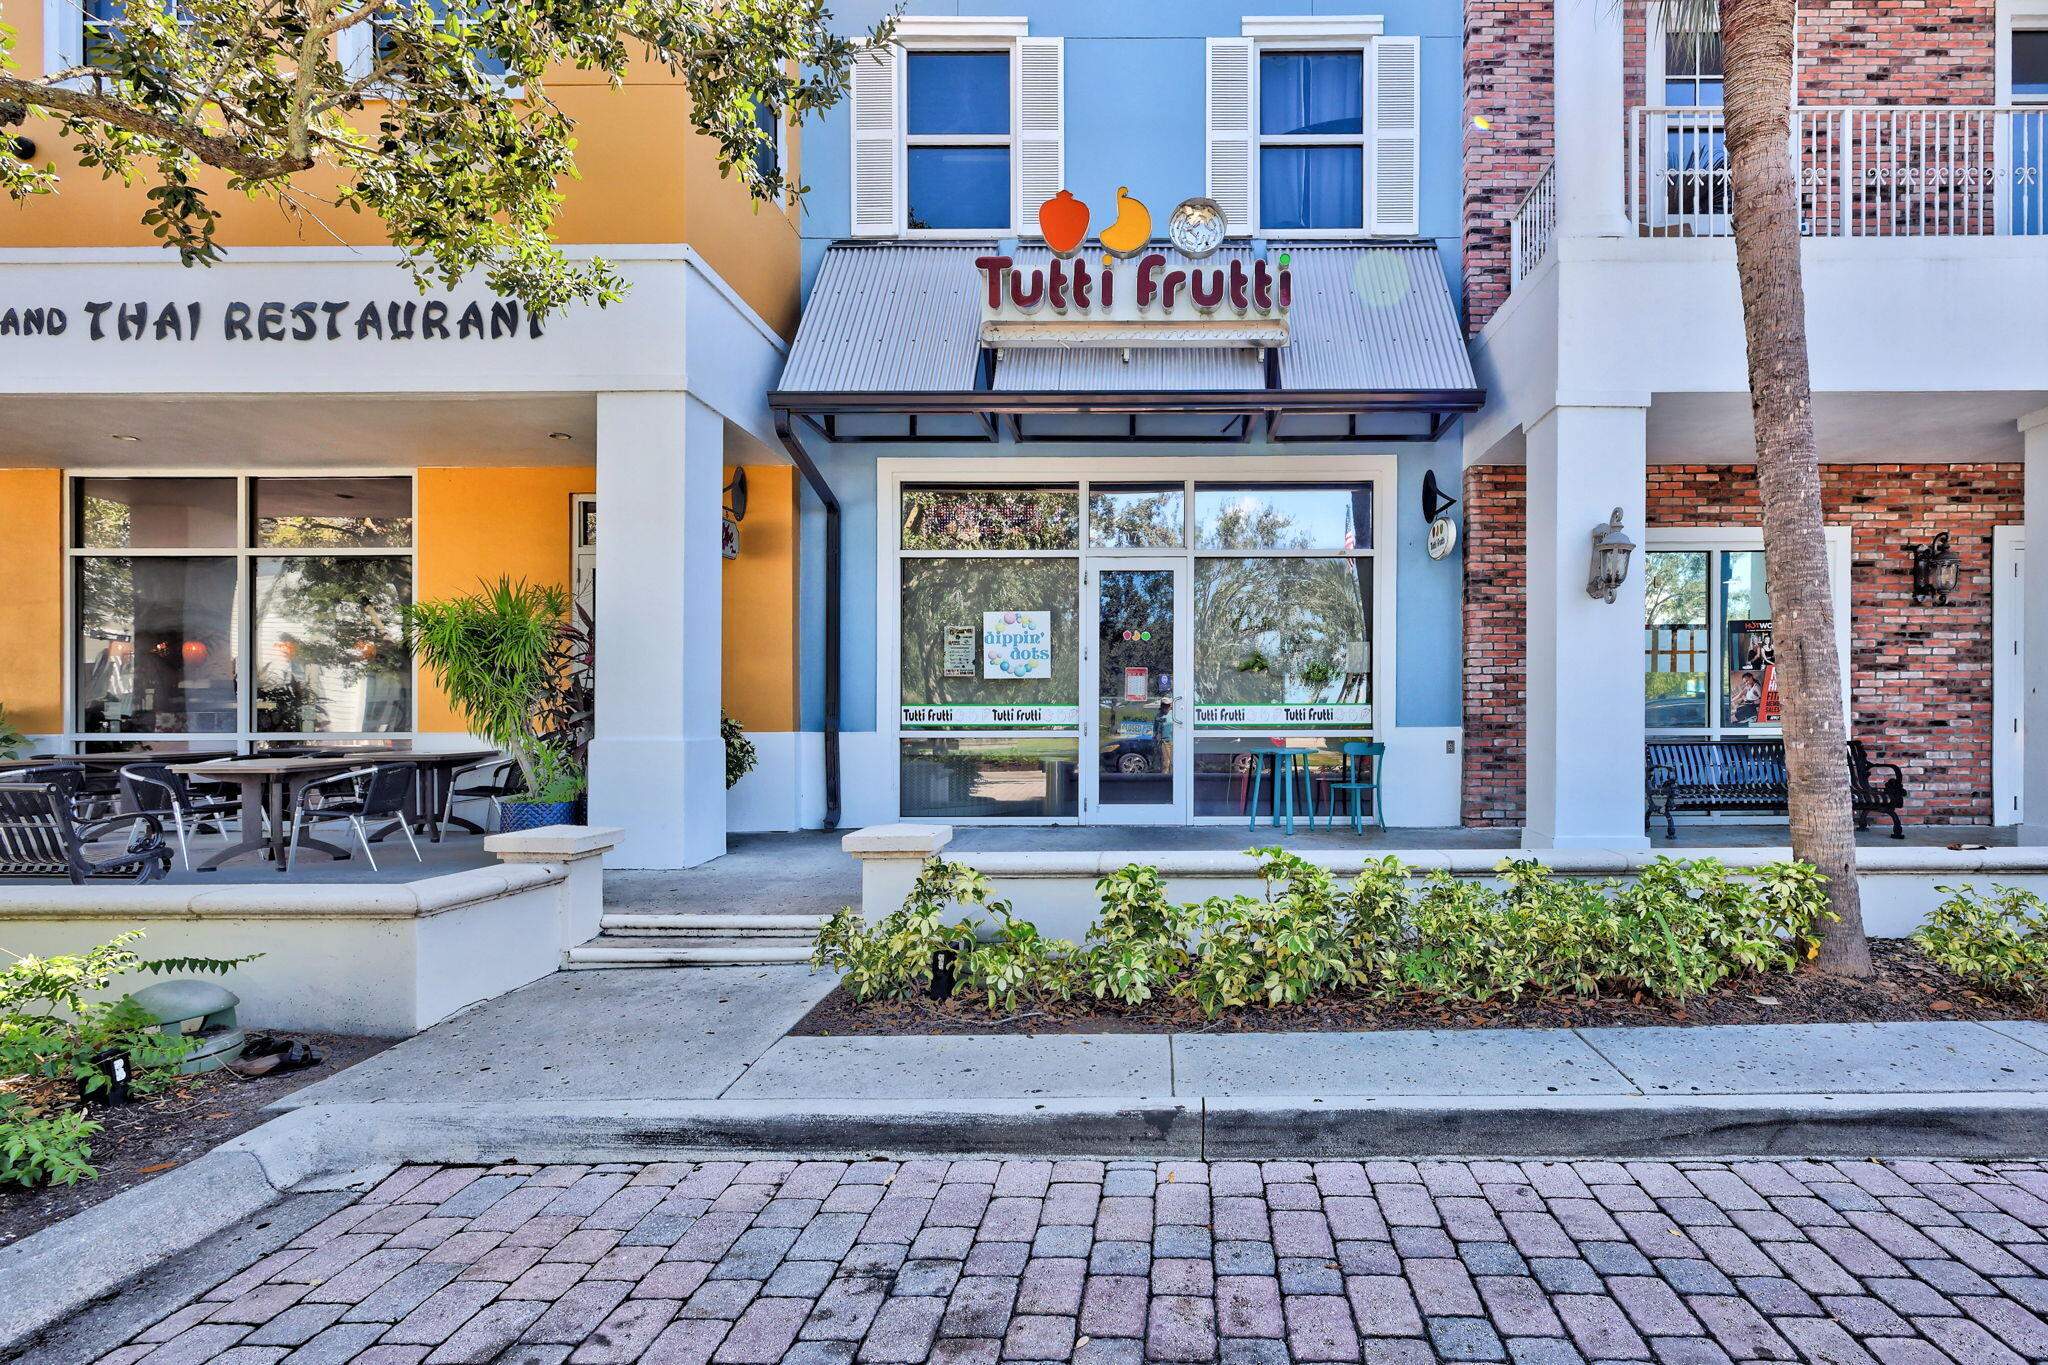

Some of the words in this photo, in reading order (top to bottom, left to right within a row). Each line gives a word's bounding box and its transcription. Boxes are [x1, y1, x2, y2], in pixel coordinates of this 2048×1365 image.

[974, 254, 1113, 312] Tutti
[0, 307, 67, 336] AND
[84, 301, 201, 341] THAI
[1010, 647, 1050, 660] dots
[903, 708, 926, 722] Tutti
[992, 708, 1014, 722] Tutti
[1196, 708, 1218, 722] Tutti
[1284, 707, 1306, 721] Tutti
